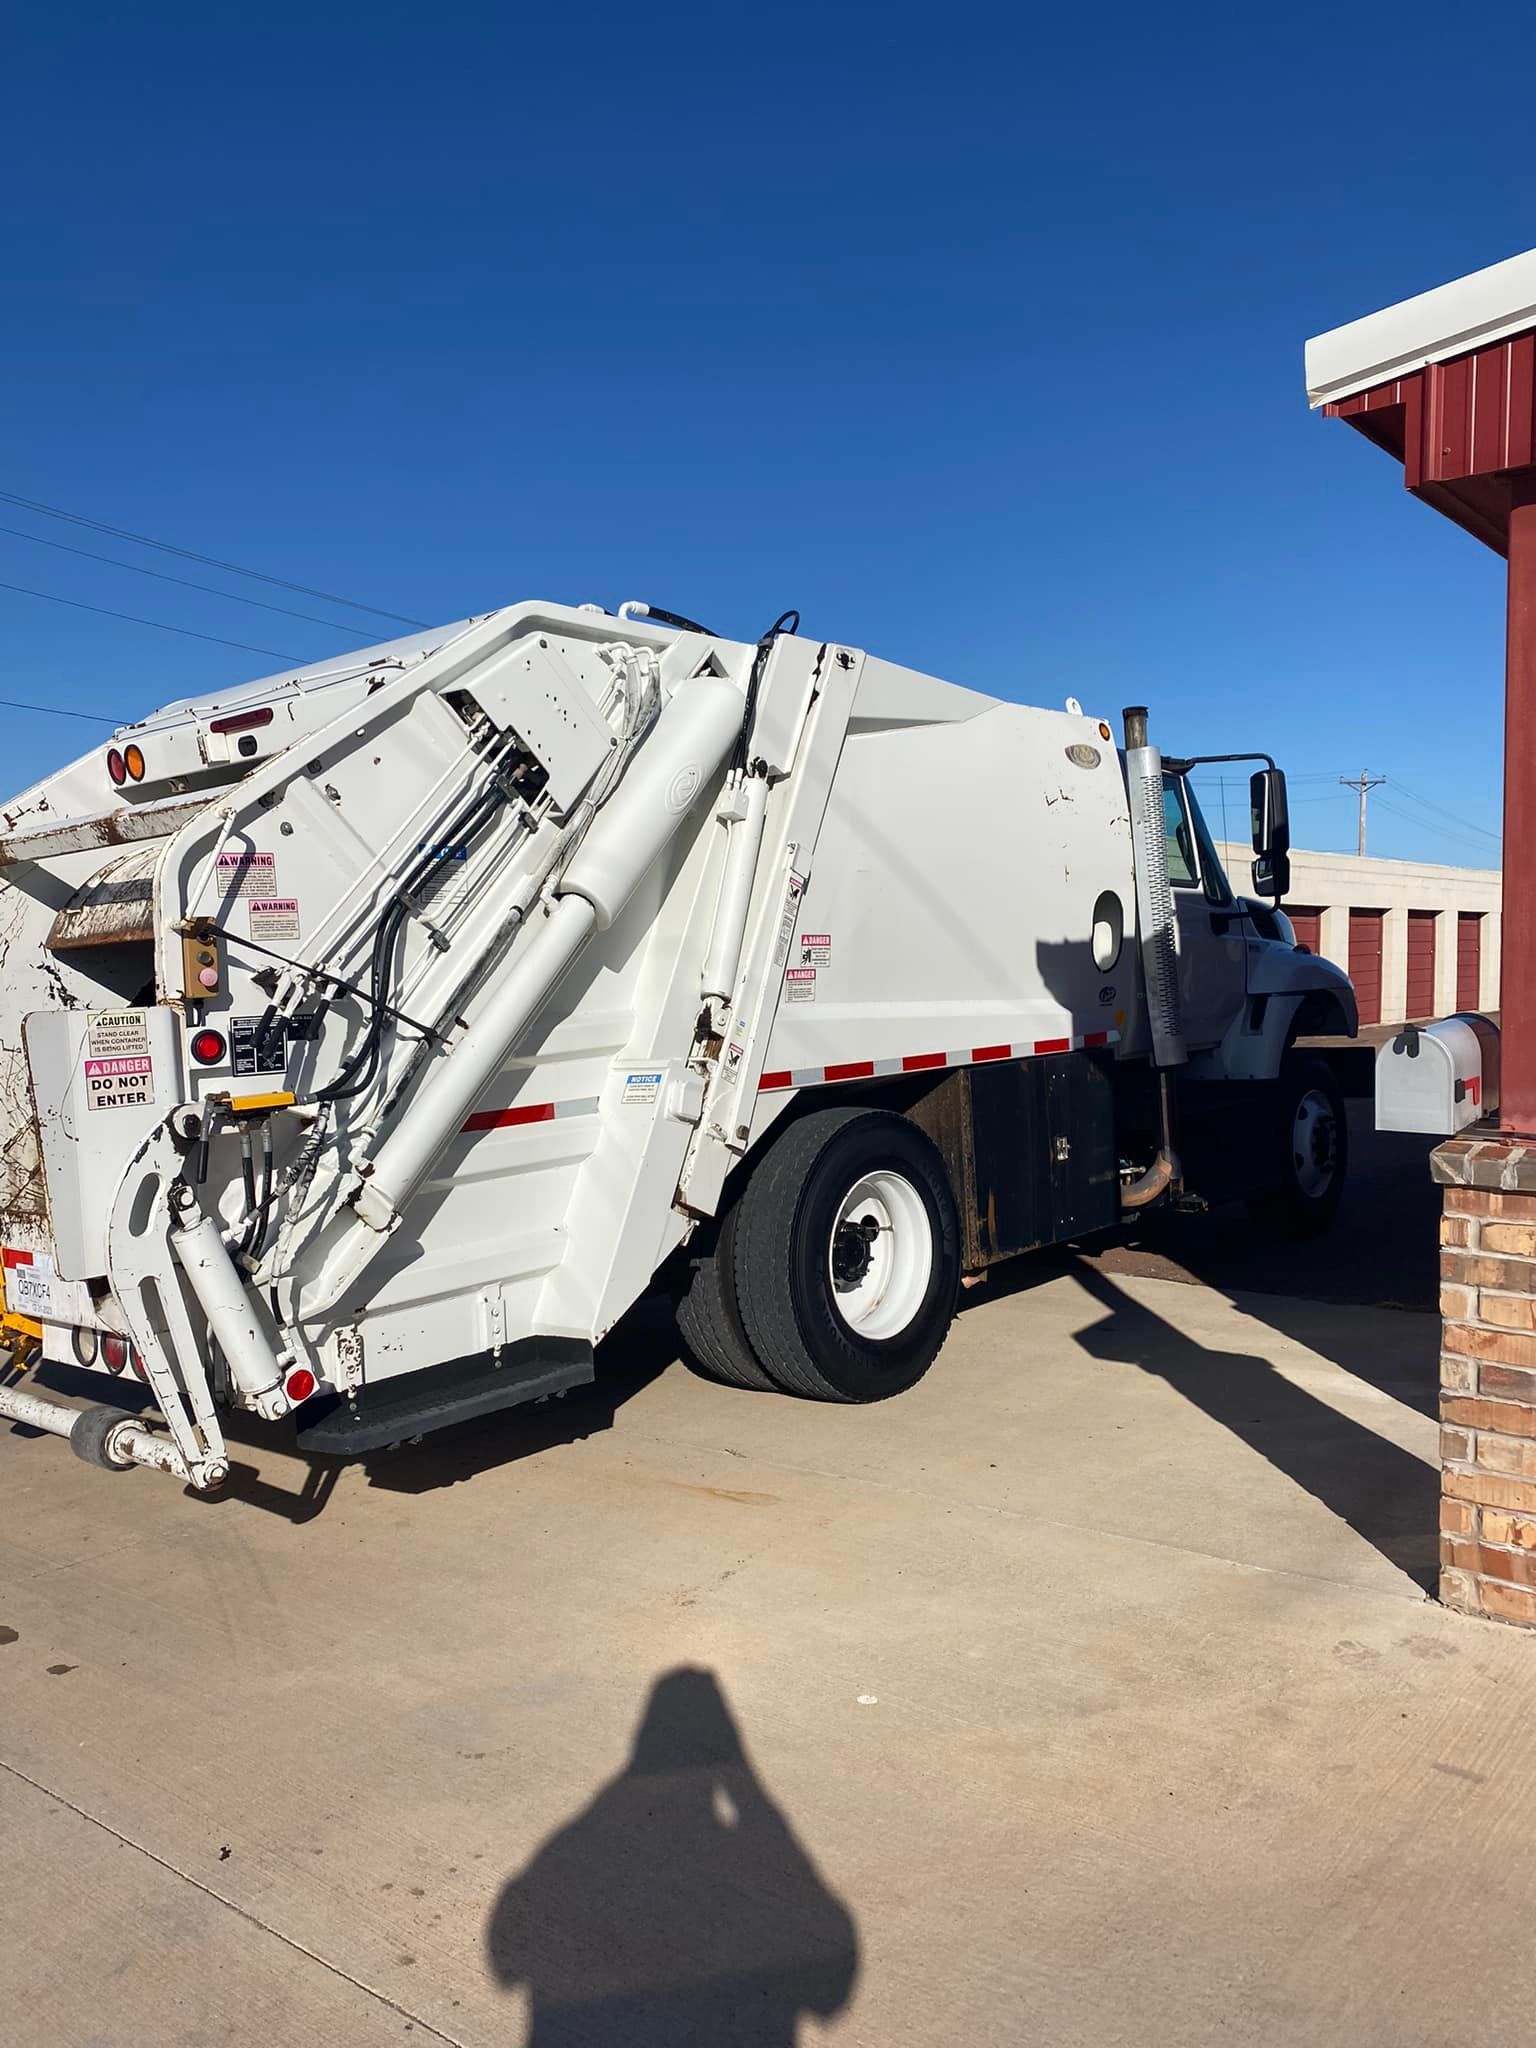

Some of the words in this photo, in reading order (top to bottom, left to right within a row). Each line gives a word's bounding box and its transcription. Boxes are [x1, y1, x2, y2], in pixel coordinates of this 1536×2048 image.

[230, 856, 273, 866] WARNING
[261, 902, 296, 910] WARNING
[102, 1015, 141, 1026] CAUTION
[102, 1059, 151, 1074] DANGER
[92, 1079, 113, 1090] DO
[119, 1075, 148, 1088] NOT
[97, 1092, 147, 1106] ENTER
